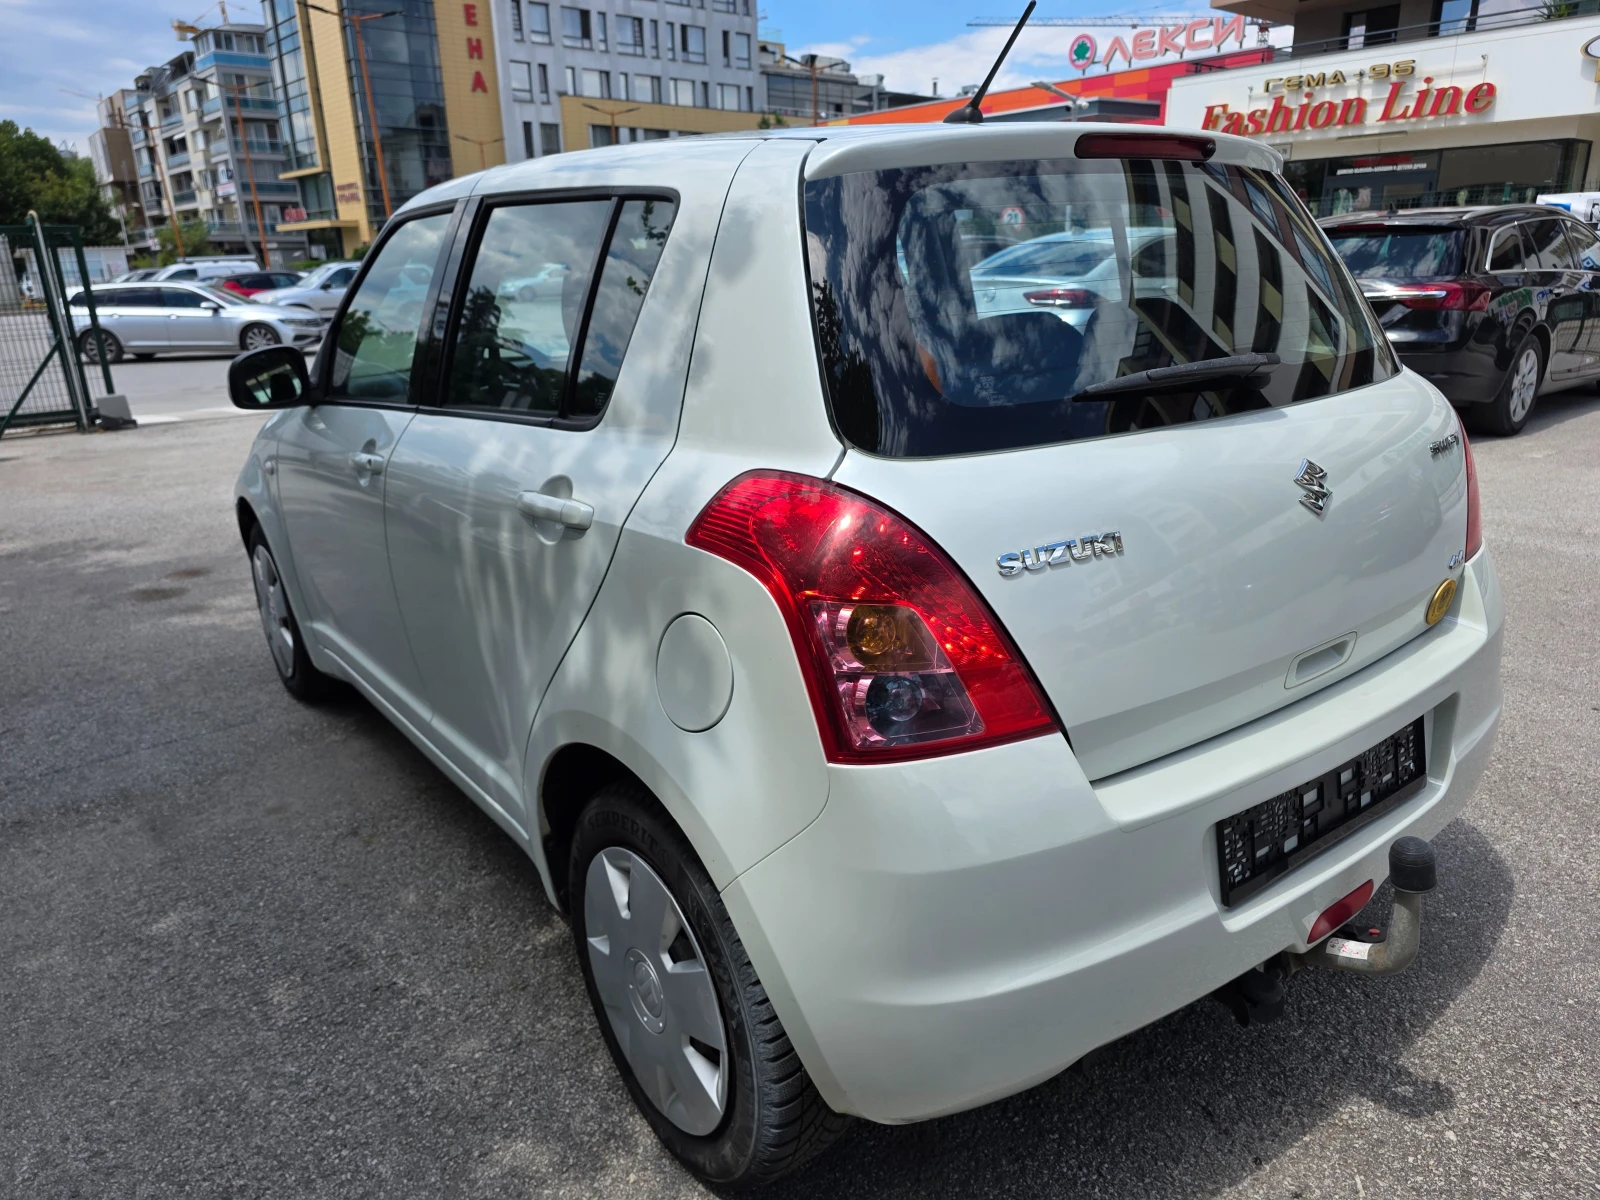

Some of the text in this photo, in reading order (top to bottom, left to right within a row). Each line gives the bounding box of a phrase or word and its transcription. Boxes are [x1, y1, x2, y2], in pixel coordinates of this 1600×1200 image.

[1102, 14, 1245, 66] ЛЕКСИ
[1263, 70, 1347, 93] ГЕМА
[1368, 59, 1416, 81] 96
[1201, 76, 1497, 137] Fashion Line
[996, 530, 1124, 576] SUZUKI
[587, 811, 659, 853] SEMPERIT
